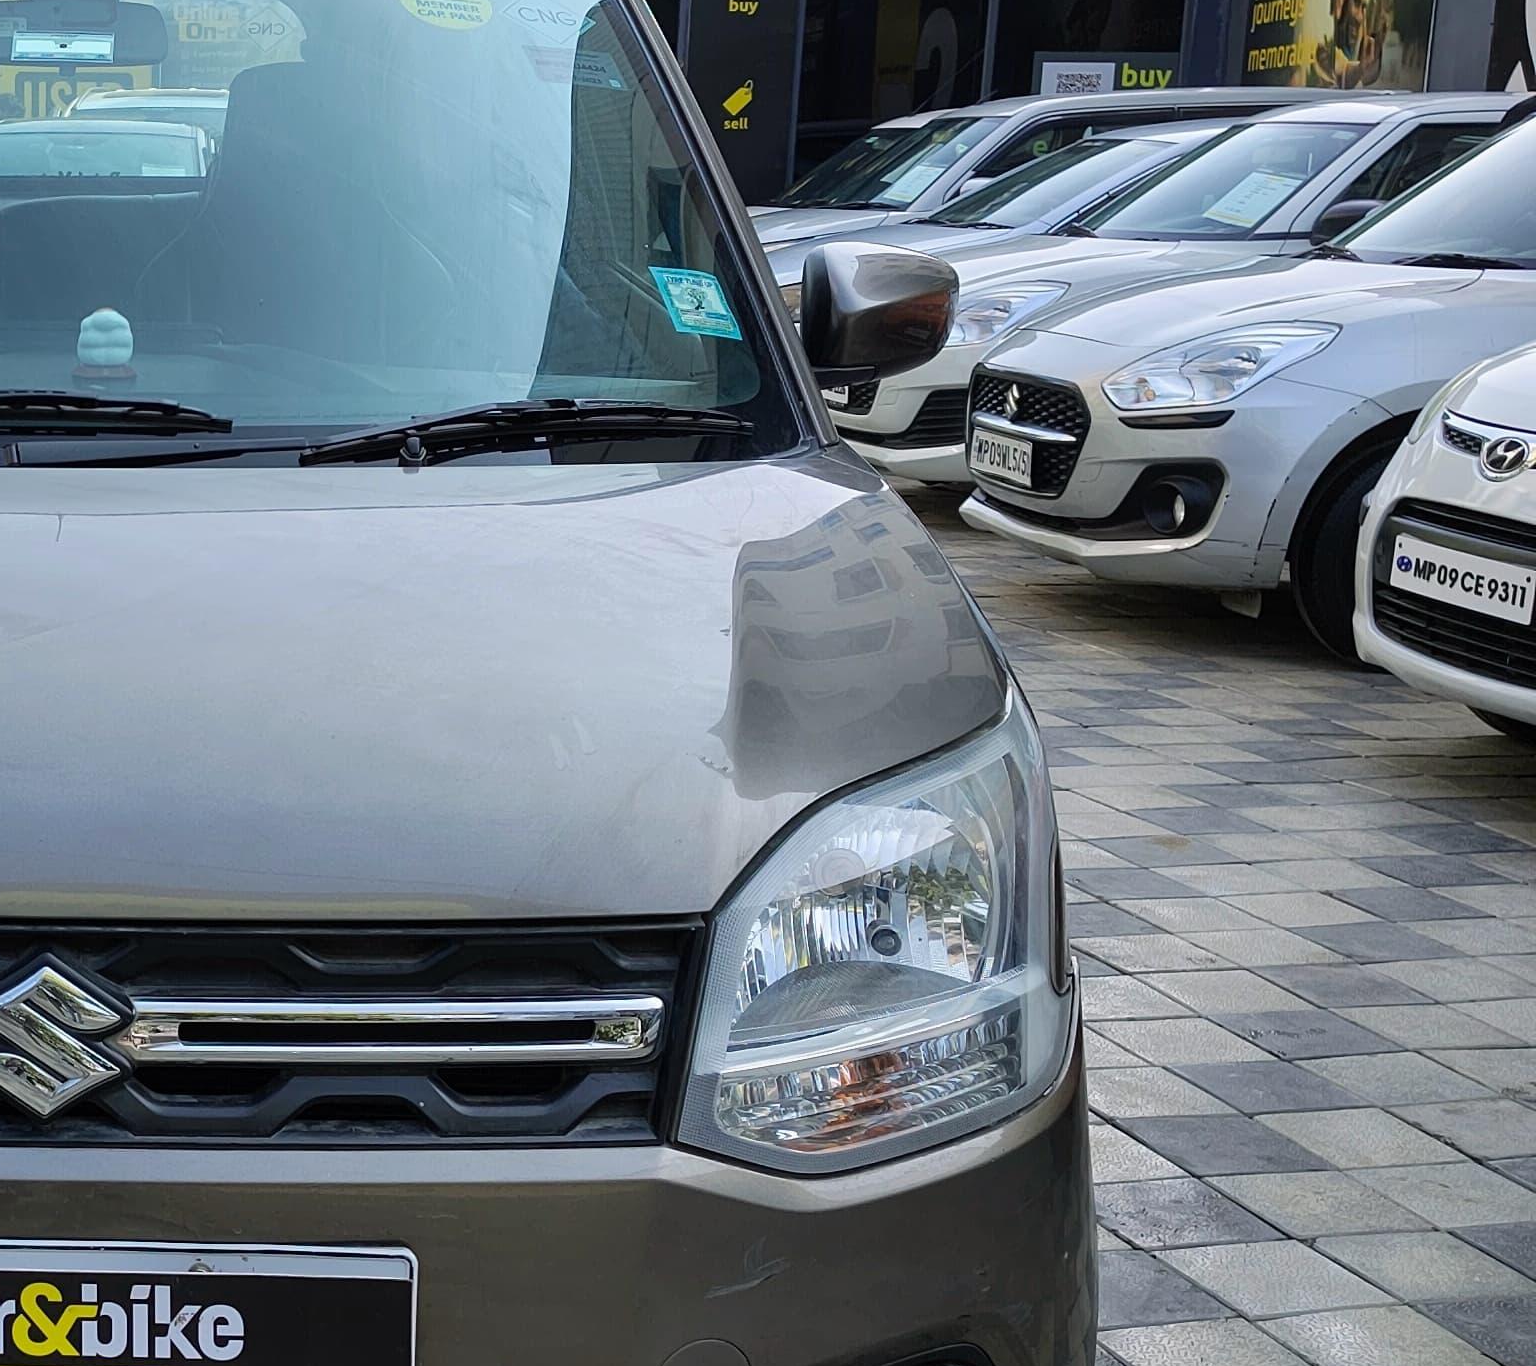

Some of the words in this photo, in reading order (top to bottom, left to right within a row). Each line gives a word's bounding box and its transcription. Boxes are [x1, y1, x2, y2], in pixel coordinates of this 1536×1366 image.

[517, 7, 577, 27] CNG
[1121, 62, 1173, 91] buy
[722, 117, 749, 130] sell
[1413, 557, 1527, 609] MP09CE9311
